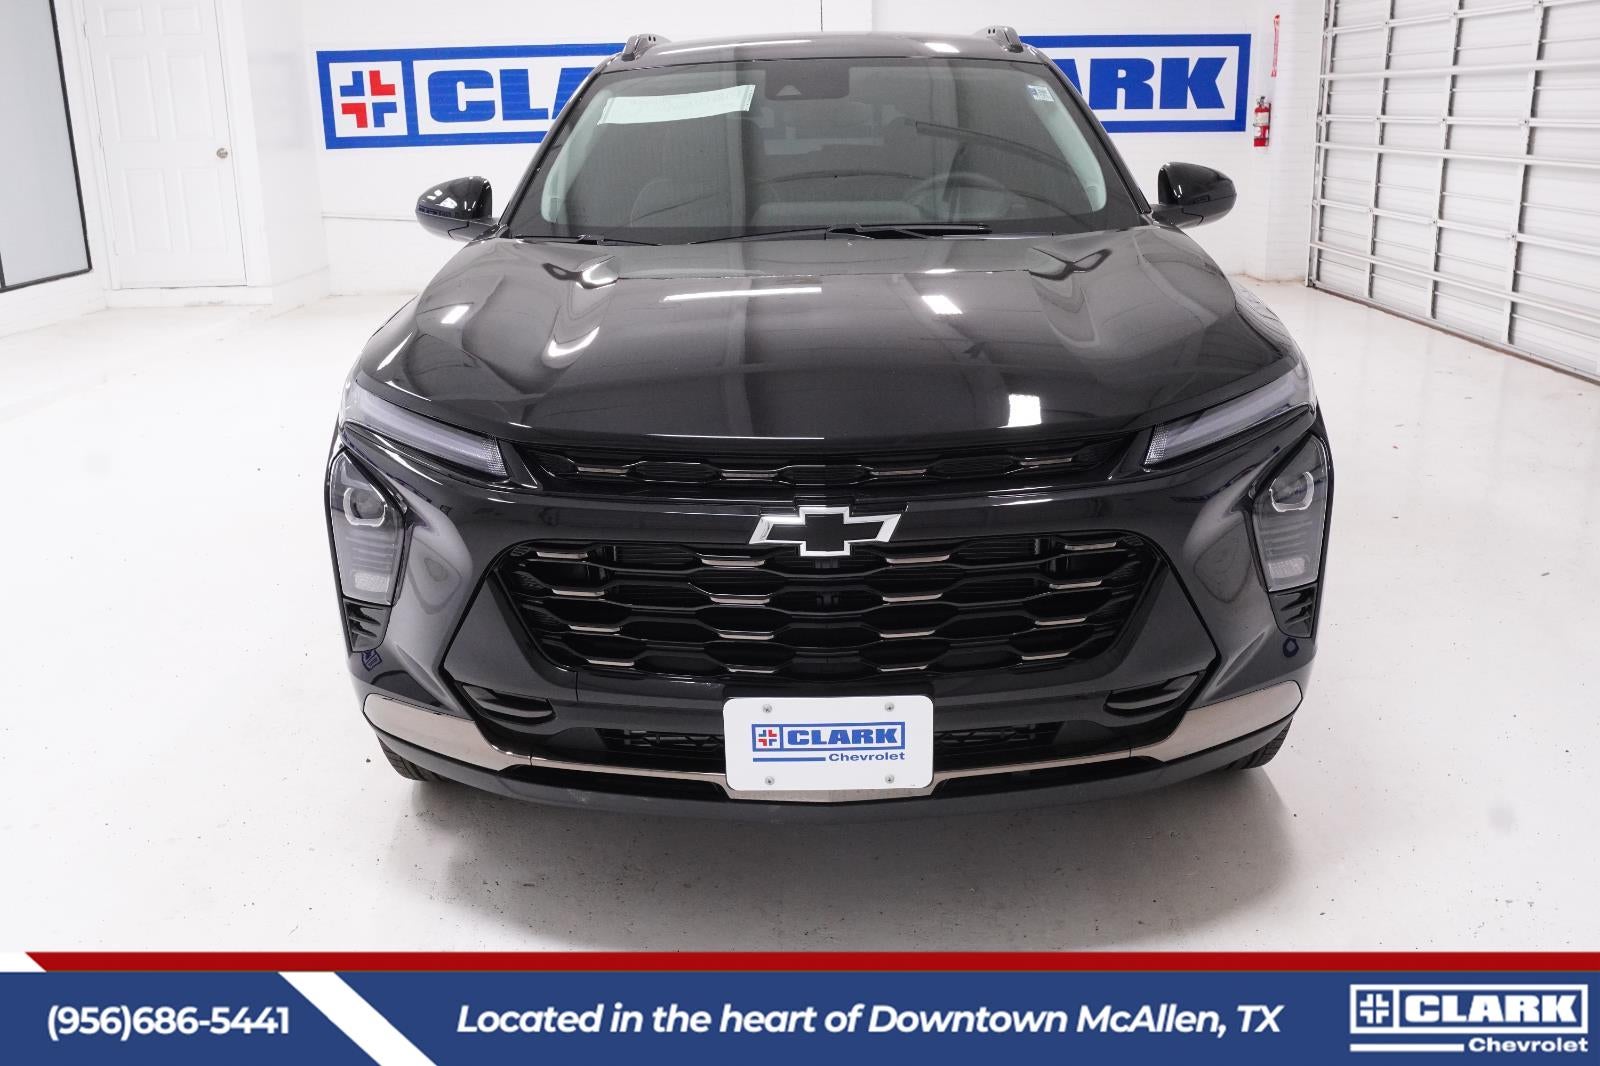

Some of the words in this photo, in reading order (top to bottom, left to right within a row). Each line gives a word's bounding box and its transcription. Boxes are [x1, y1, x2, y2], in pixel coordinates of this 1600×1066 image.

[1051, 57, 1227, 110] RK
[787, 728, 898, 746] CLARK
[828, 751, 906, 762] Chevrolet
